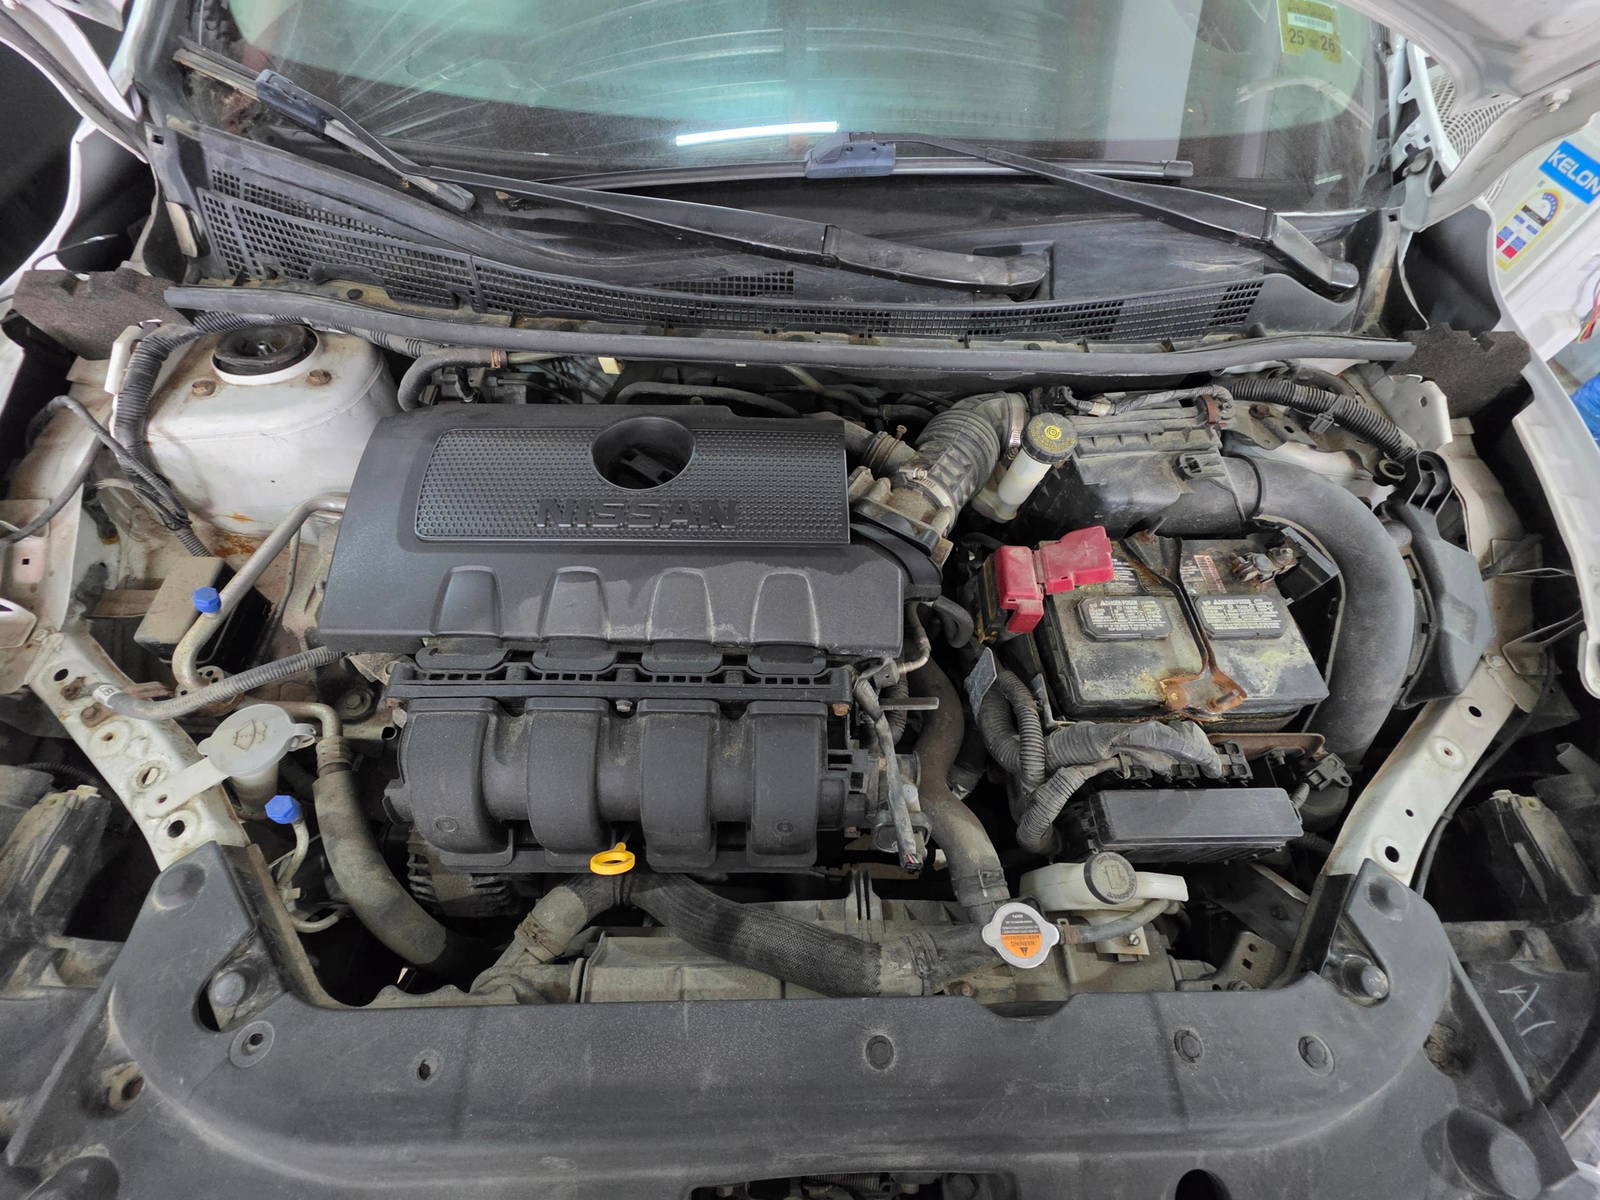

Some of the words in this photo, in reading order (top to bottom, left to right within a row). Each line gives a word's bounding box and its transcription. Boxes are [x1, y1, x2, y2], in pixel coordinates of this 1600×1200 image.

[1289, 28, 1305, 46] 25
[1320, 35, 1336, 54] 26
[537, 498, 737, 528] NISSAN
